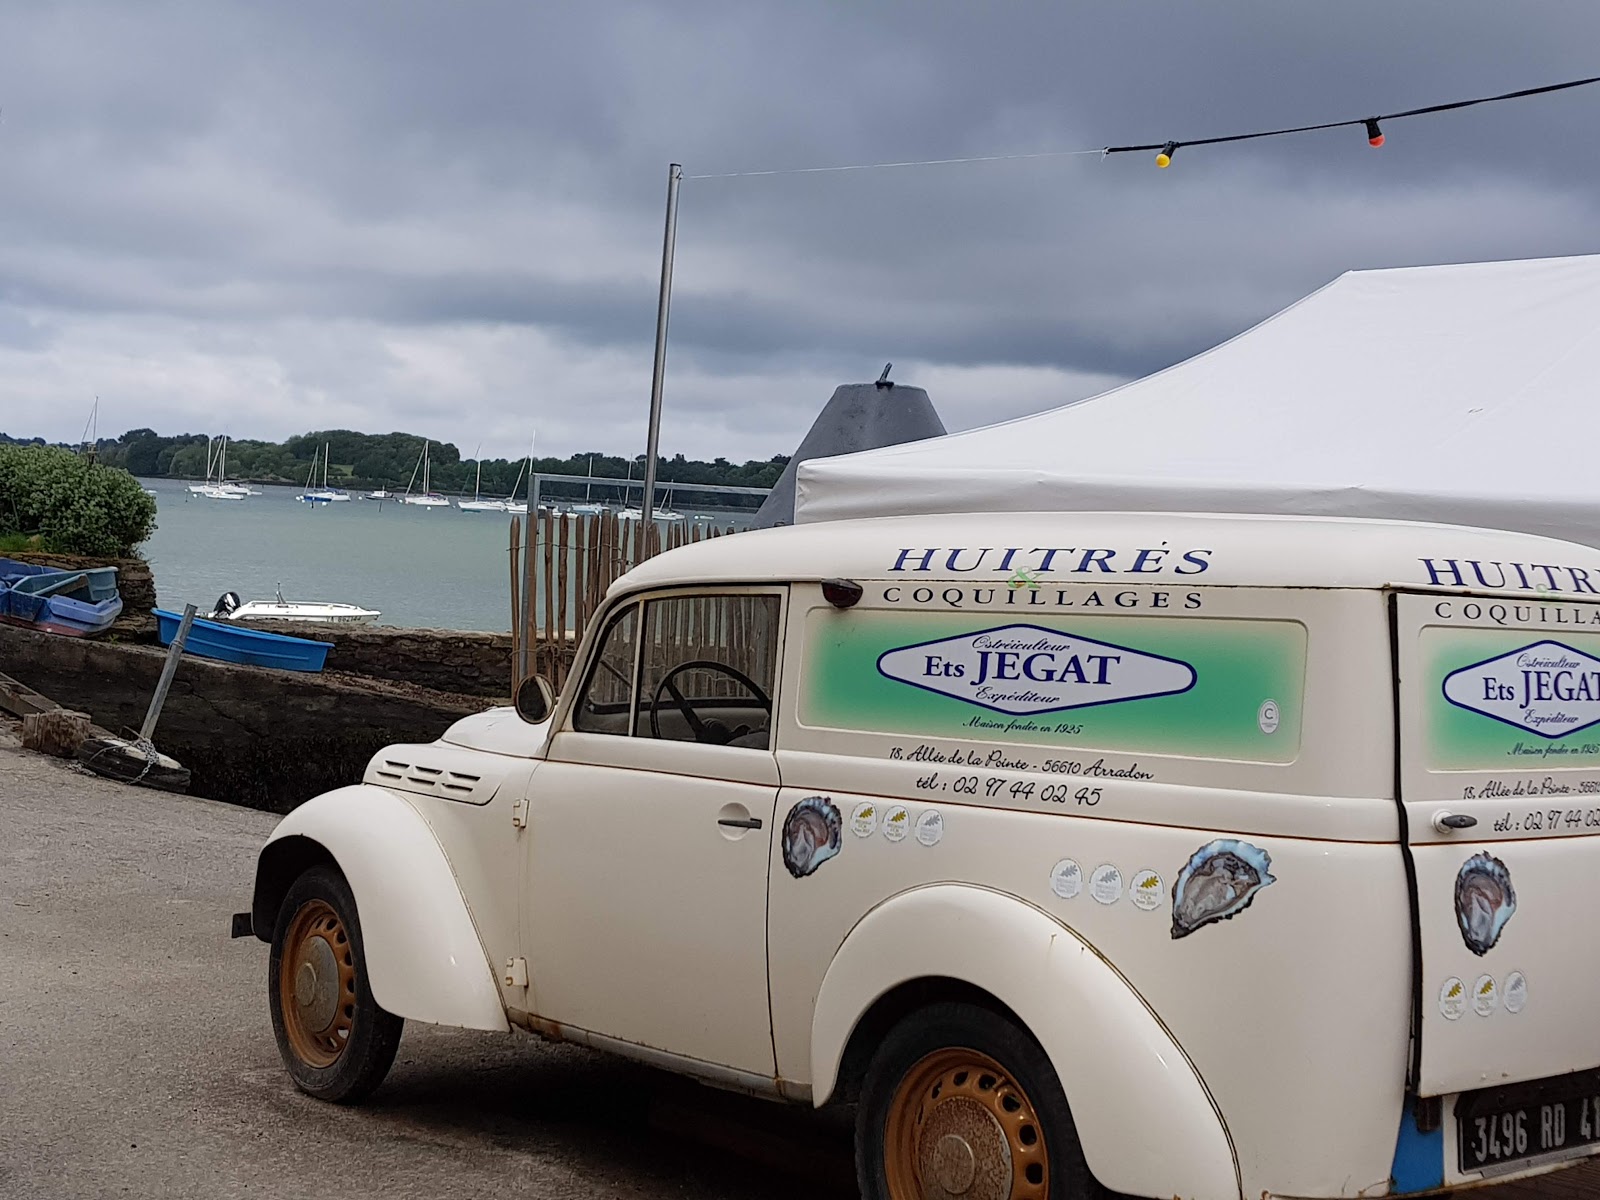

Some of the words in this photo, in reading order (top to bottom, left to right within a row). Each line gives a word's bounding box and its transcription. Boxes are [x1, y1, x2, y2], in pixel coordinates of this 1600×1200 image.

[1008, 566, 1044, 589] &
[1418, 558, 1600, 594] HUITR
[883, 588, 1202, 610] COQUILLAGES
[971, 634, 1070, 652] Ostréiculteur
[922, 655, 965, 678] Ets
[970, 650, 1121, 686] JEGAT
[975, 686, 1060, 704] Expéditeur
[1482, 677, 1515, 701] Ets
[1264, 708, 1274, 719] C
[962, 716, 1005, 729] Maison
[1004, 719, 1038, 733] fondée
[1054, 723, 1084, 735] 1925
[907, 744, 947, 763] Allée
[948, 749, 965, 765] de
[967, 750, 983, 766] la
[985, 750, 1029, 770] Pointe
[1041, 760, 1081, 775] 56610
[1083, 759, 1154, 780] Arradon
[953, 776, 979, 795] 02
[986, 777, 1008, 797] 97
[1009, 781, 1036, 800] 44
[1040, 784, 1067, 803] 02
[1074, 787, 1103, 806] 45
[1512, 780, 1525, 796] de
[1526, 780, 1539, 796] la
[1540, 776, 1570, 795] Pointe
[1523, 811, 1543, 831] 02
[1547, 809, 1563, 830] 97
[1564, 809, 1582, 828] 44
[1473, 1110, 1528, 1162] 3496
[1541, 1103, 1565, 1149] RD
